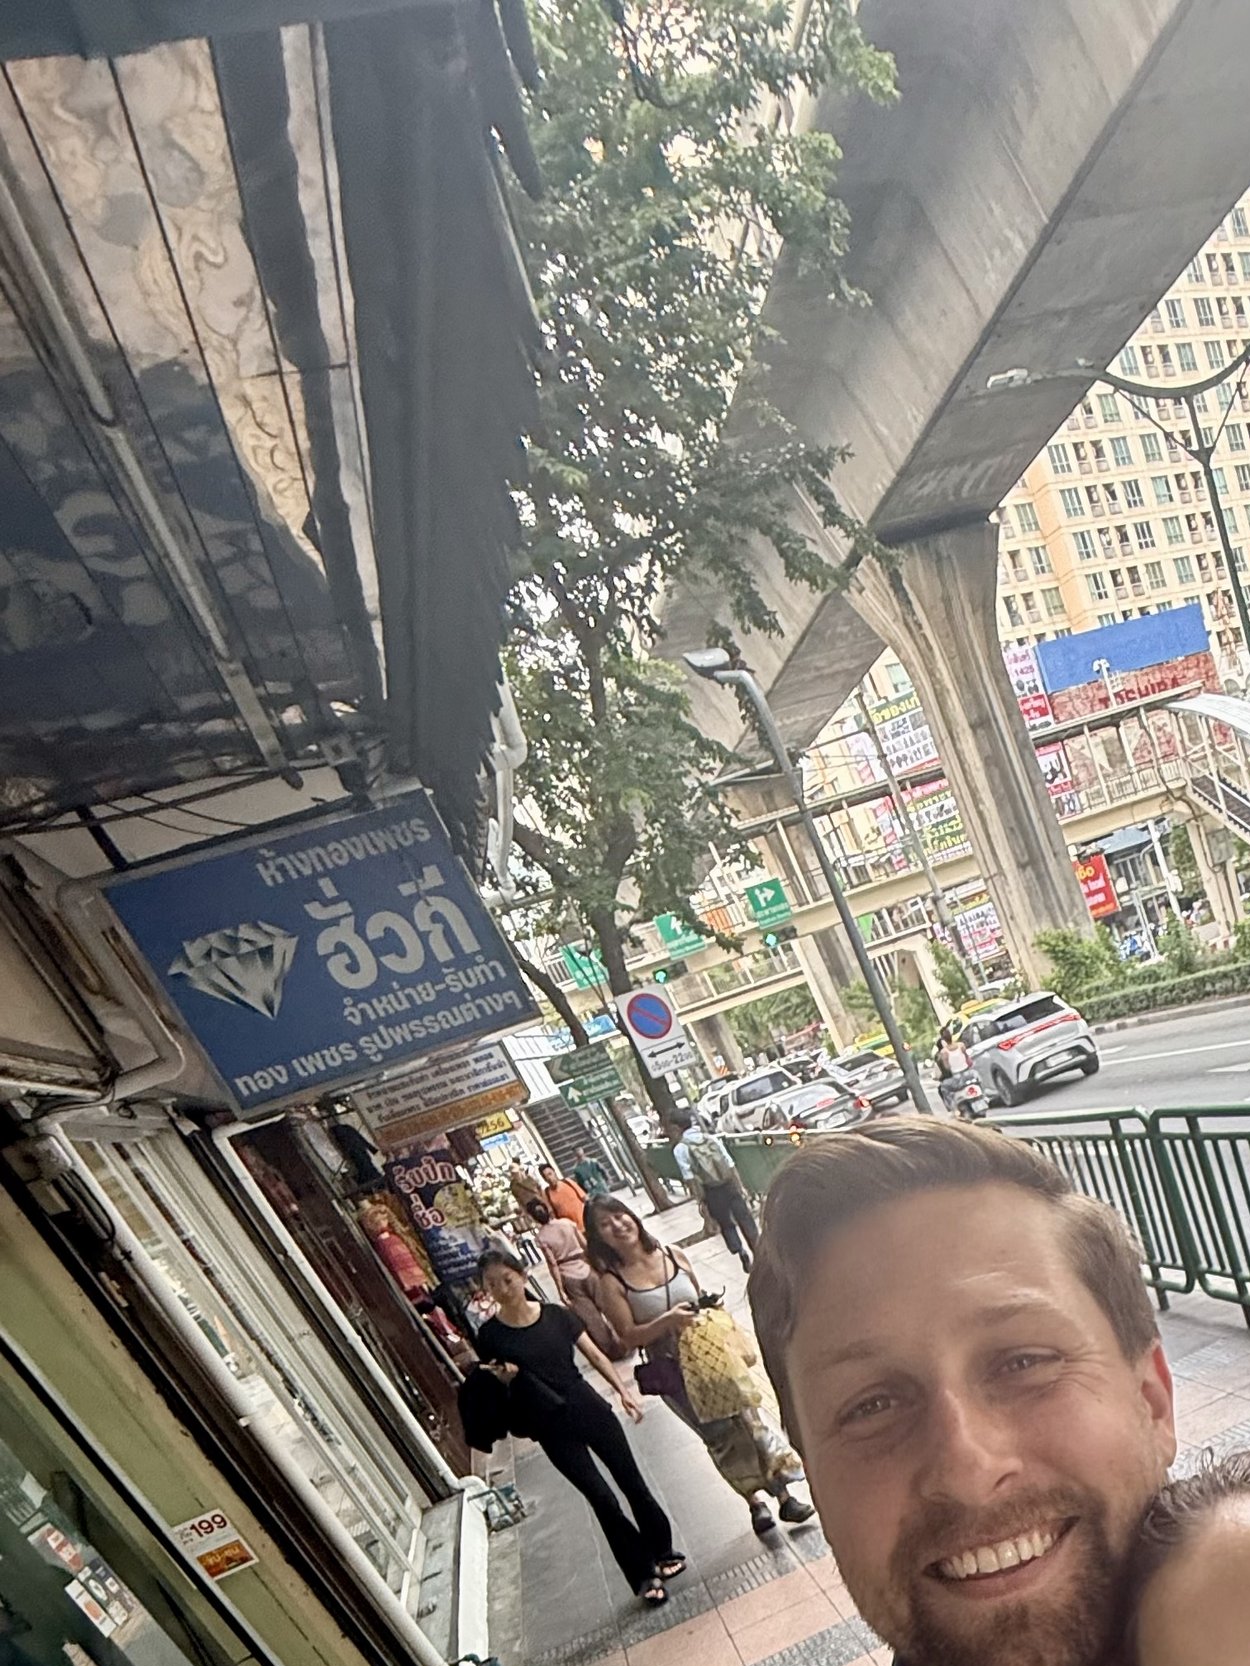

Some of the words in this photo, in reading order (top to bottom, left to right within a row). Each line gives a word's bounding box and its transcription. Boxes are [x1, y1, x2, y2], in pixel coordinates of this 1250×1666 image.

[256, 817, 432, 888] ห้างทองเพชร
[342, 958, 507, 1027] จำหน่าย-รับทำ
[296, 1034, 358, 1075] เพชร
[190, 1513, 228, 1540] 199
